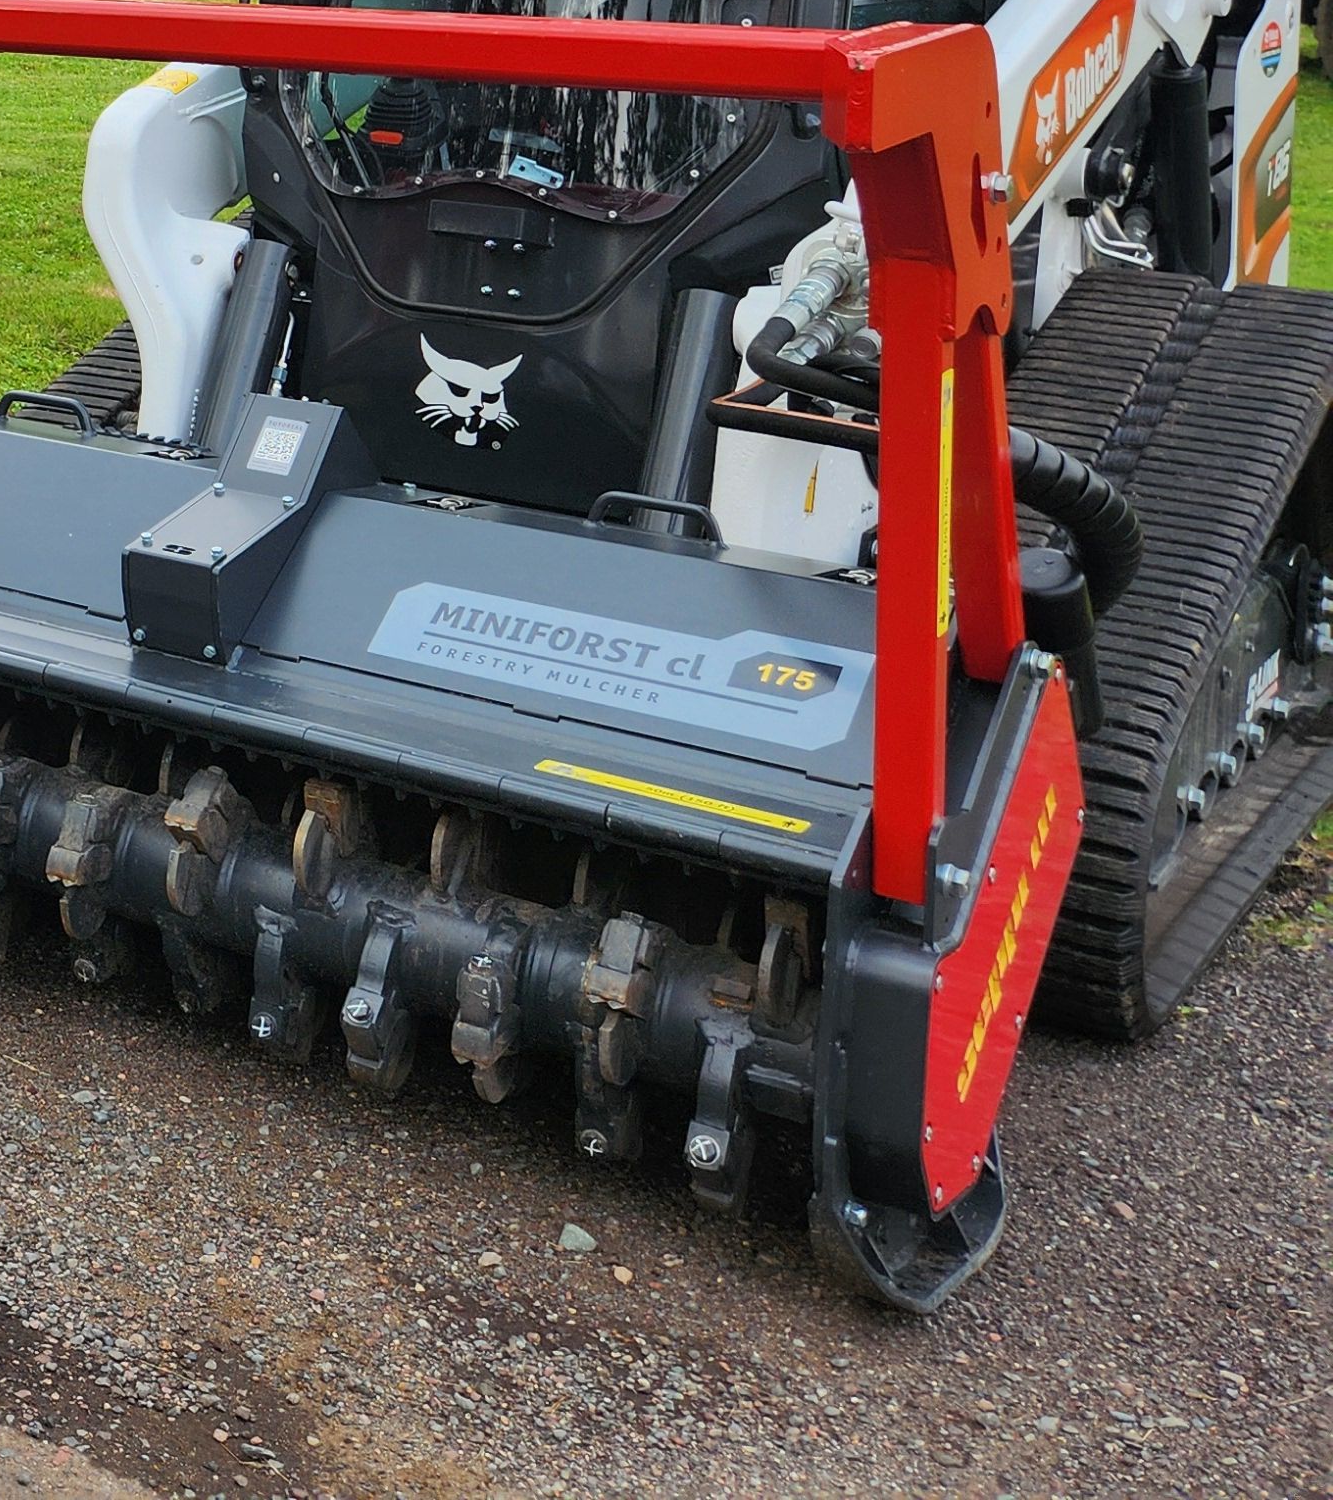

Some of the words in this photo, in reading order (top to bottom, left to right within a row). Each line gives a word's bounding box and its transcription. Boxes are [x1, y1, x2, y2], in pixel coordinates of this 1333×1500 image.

[1064, 14, 1120, 134] Bobcat
[416, 641, 535, 675] FORESTRY
[546, 670, 661, 703] MULCHER
[430, 602, 661, 668] MINIFORST
[666, 654, 706, 680] cl
[758, 663, 816, 692] 175
